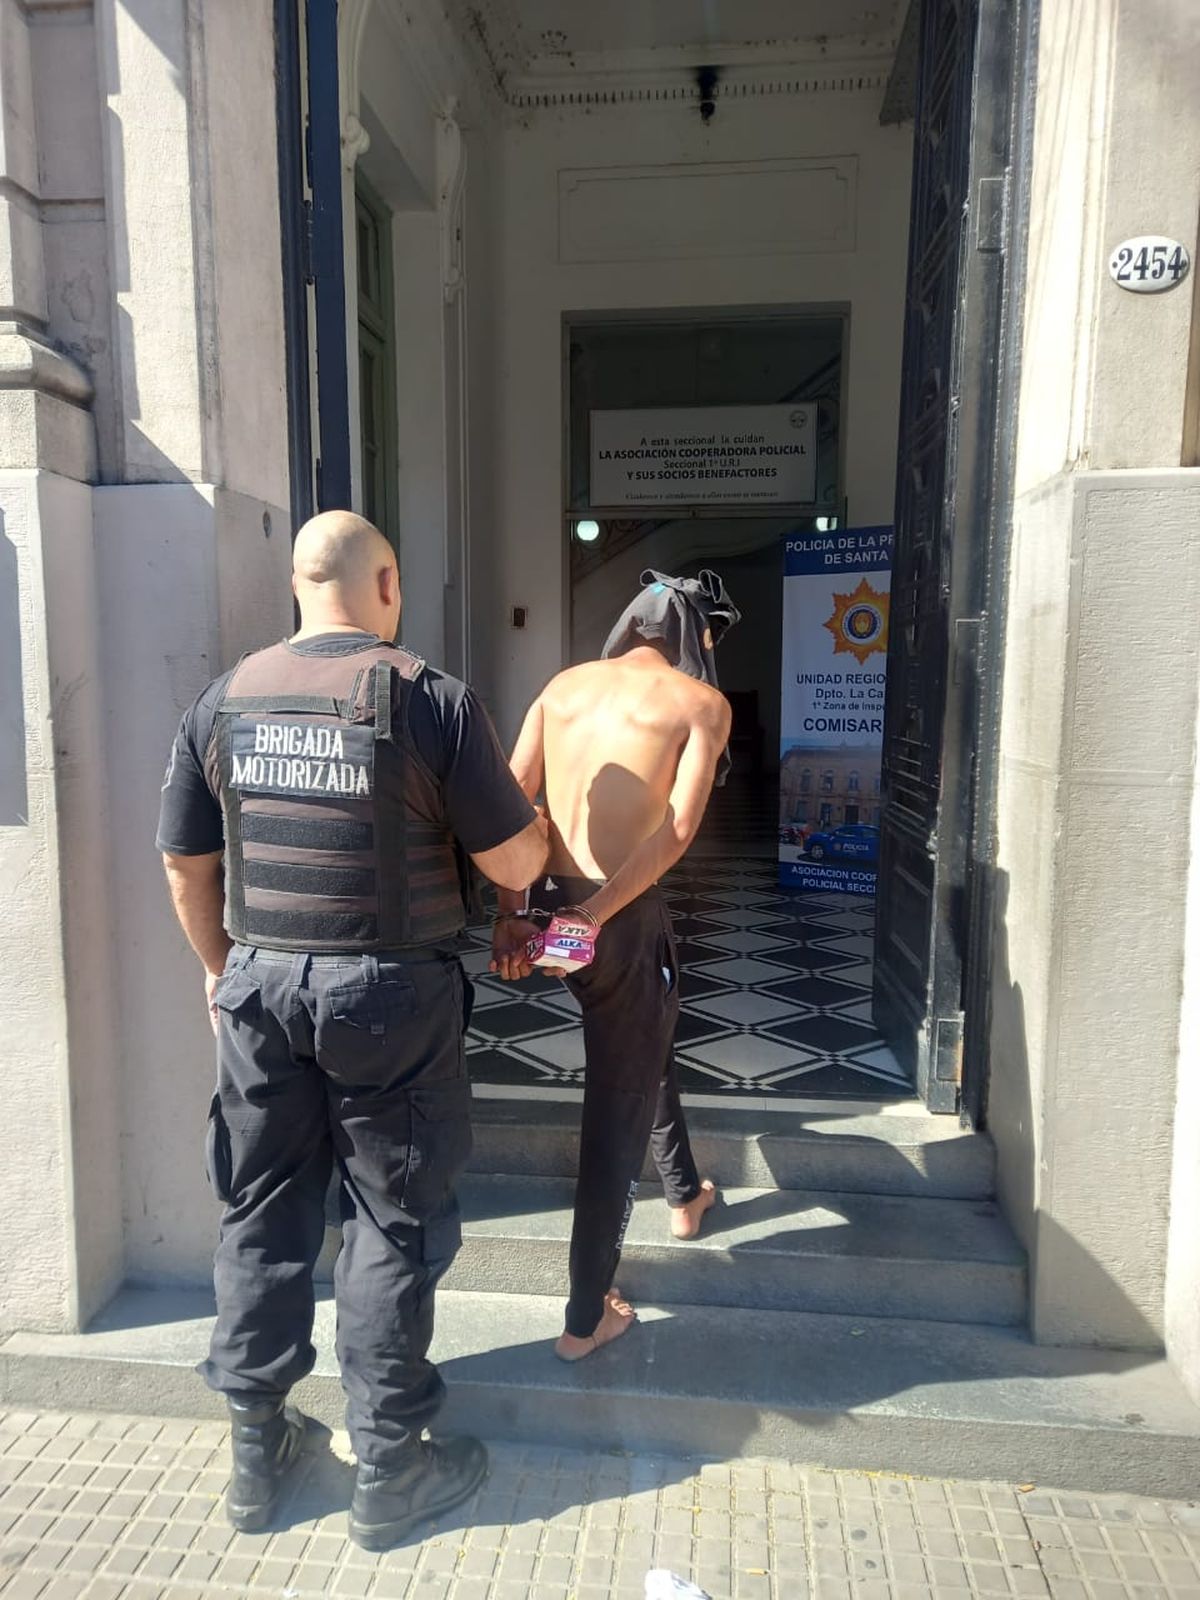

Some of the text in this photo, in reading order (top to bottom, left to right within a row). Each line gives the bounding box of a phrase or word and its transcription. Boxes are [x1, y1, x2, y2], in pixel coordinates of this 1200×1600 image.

[1117, 246, 1183, 280] 2454
[640, 433, 765, 446] A esta seccional la cuidan
[599, 450, 612, 460] LA
[678, 446, 757, 459] COOPERADORA
[760, 445, 806, 456] POLICIAL
[663, 459, 706, 469] Seccional
[626, 468, 777, 480] Y SUS SOCIOS BENEFACTORES
[785, 539, 834, 552] POLICIA
[838, 538, 856, 549] DE
[859, 536, 876, 547] LA
[824, 550, 889, 565] DE SANTA
[796, 673, 886, 684] UNIDAD REGIO
[815, 688, 846, 700] Dpto.
[849, 688, 865, 699] La
[823, 702, 846, 710] Zona
[848, 701, 860, 710] de
[803, 717, 882, 733] COMISAR
[254, 723, 344, 760] BRIGADA
[231, 754, 370, 796] MOTORIZADA
[791, 865, 849, 880] ASOCIACION
[802, 878, 845, 891] POLICIAL
[556, 939, 582, 949] ALKA
